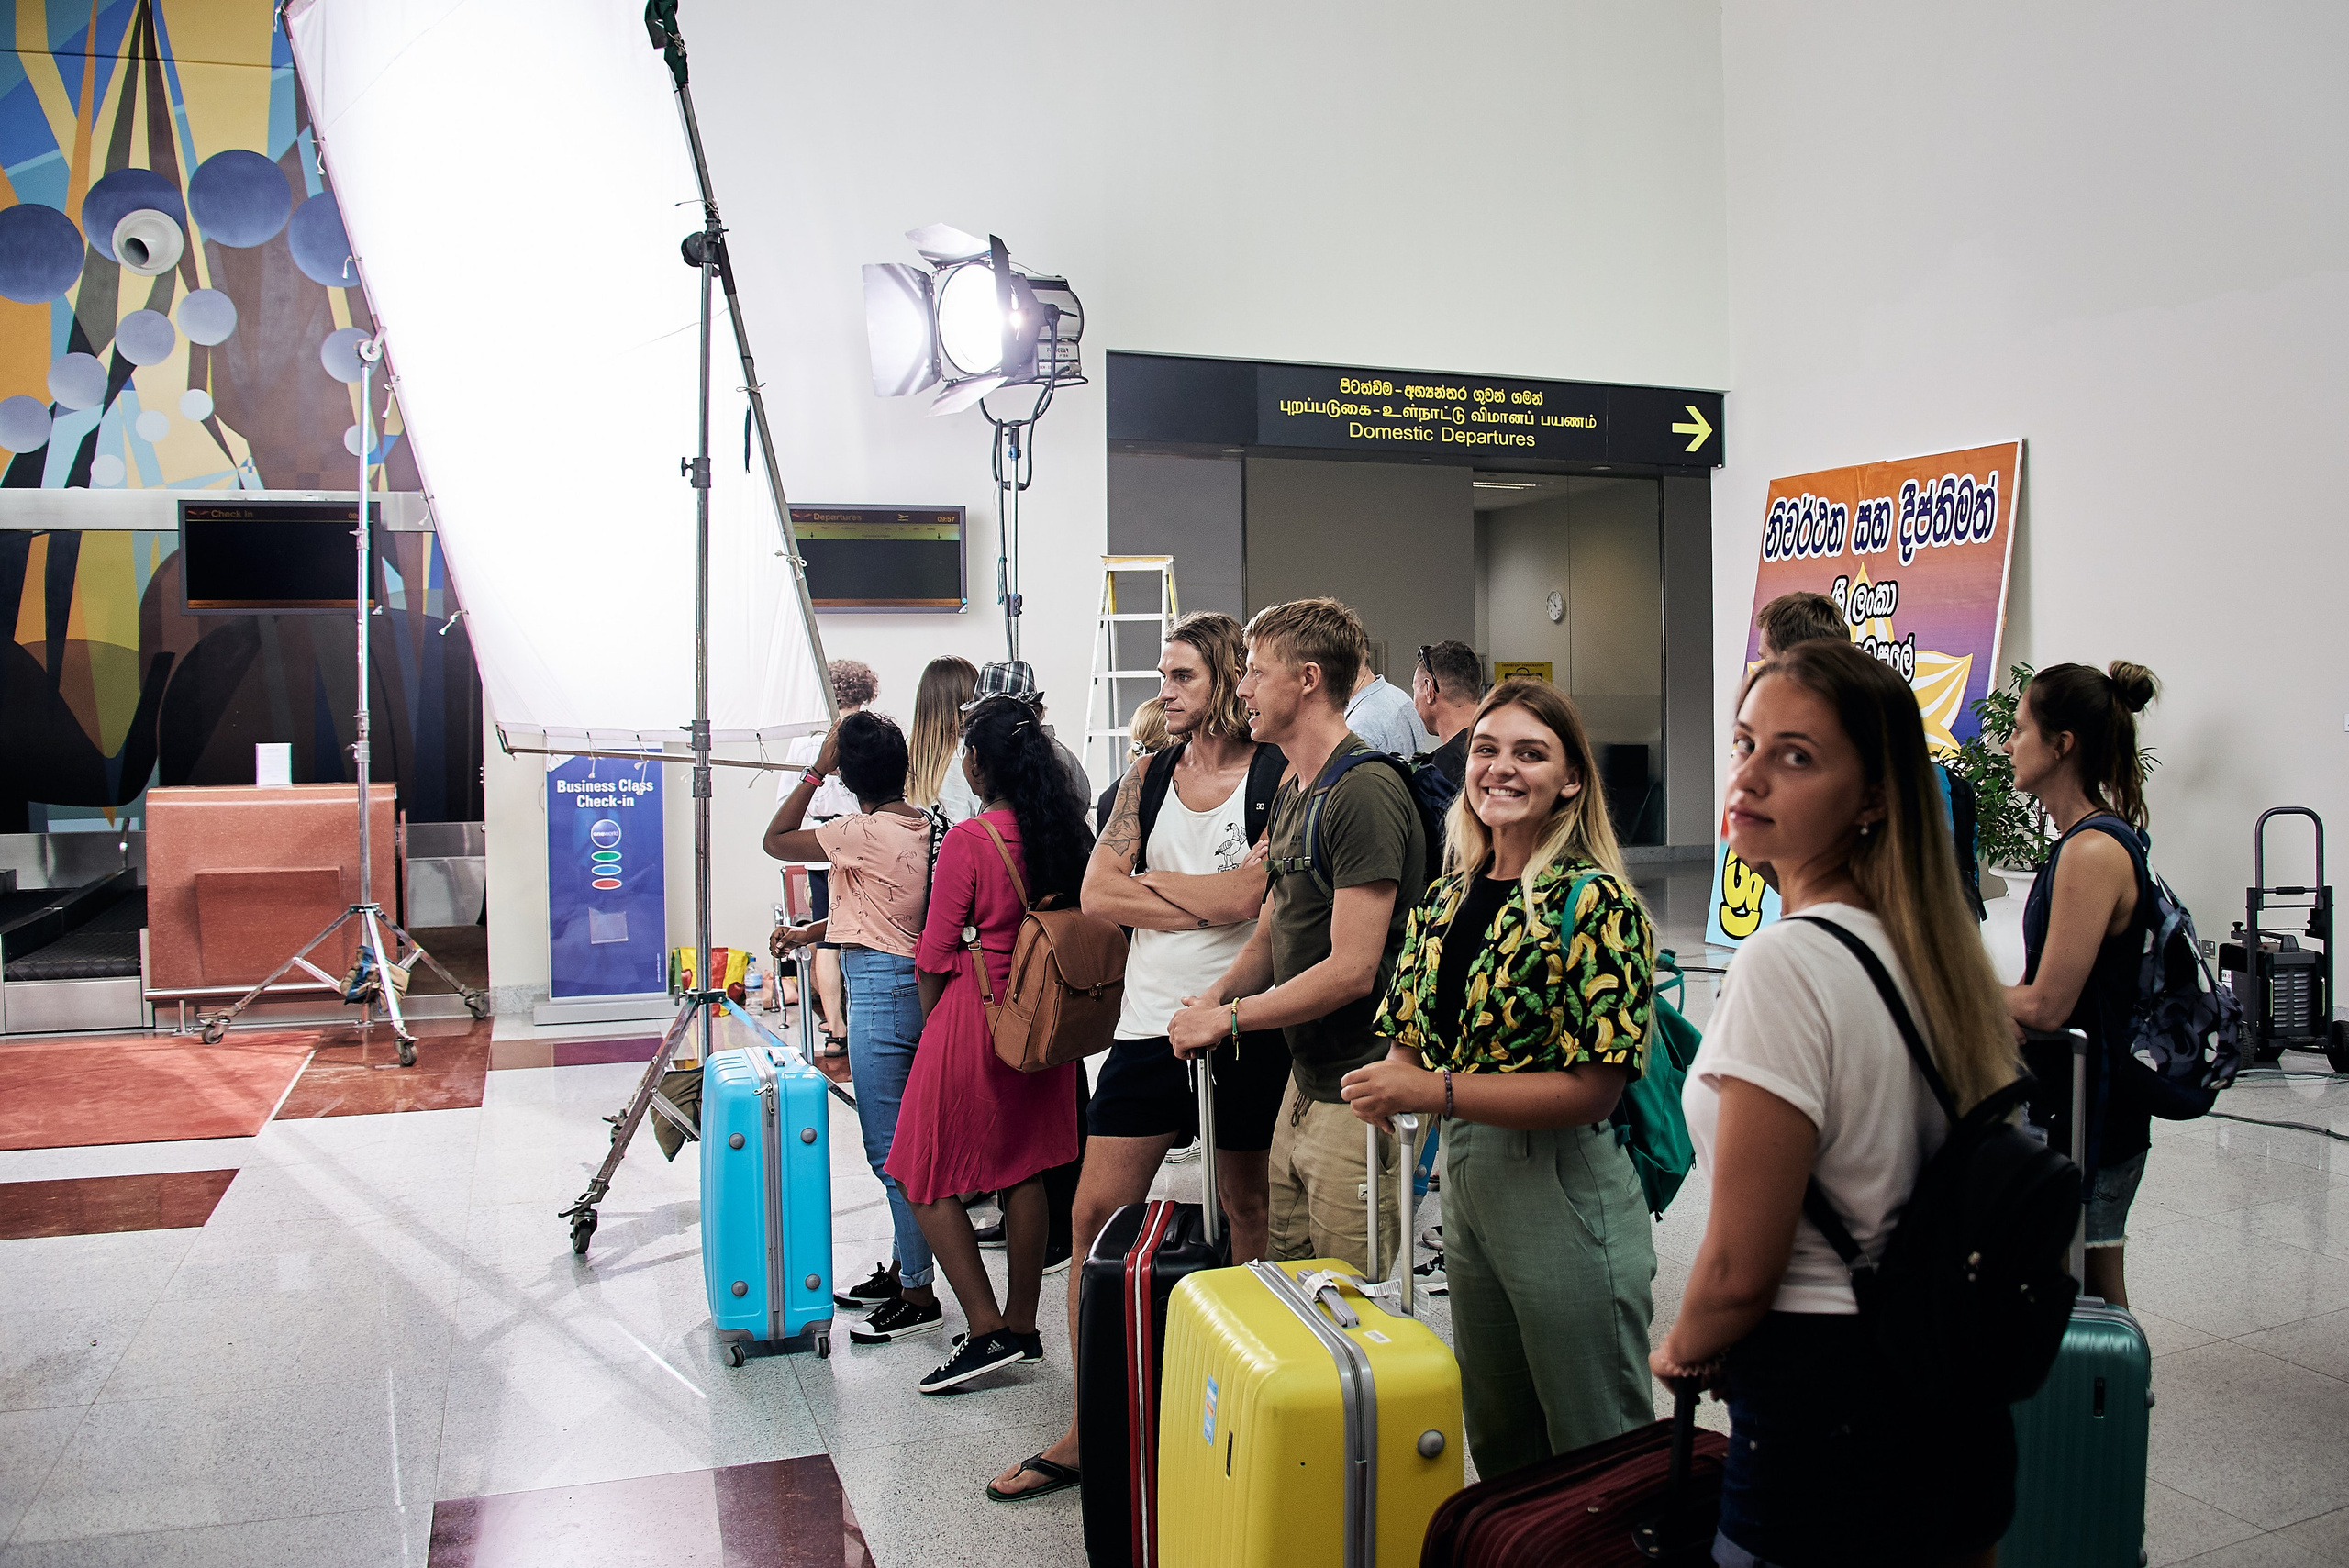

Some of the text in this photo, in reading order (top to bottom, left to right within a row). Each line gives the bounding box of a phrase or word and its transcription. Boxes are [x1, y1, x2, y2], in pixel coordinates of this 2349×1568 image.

[1473, 387, 1506, 406] ගුවන්
[1511, 390, 1543, 406] ගමන්
[1471, 406, 1535, 425] விமானப்
[1541, 413, 1598, 428] பயணம்
[1349, 422, 1536, 447] Domestic Departures
[211, 509, 253, 518] Check In
[813, 512, 862, 522] Departures
[1853, 498, 1892, 554] සහ
[1898, 472, 1998, 564] දීප්තිමත්
[1851, 581, 1898, 624] ලංකා
[556, 778, 654, 794] Business Class
[576, 794, 635, 808] Check-in
